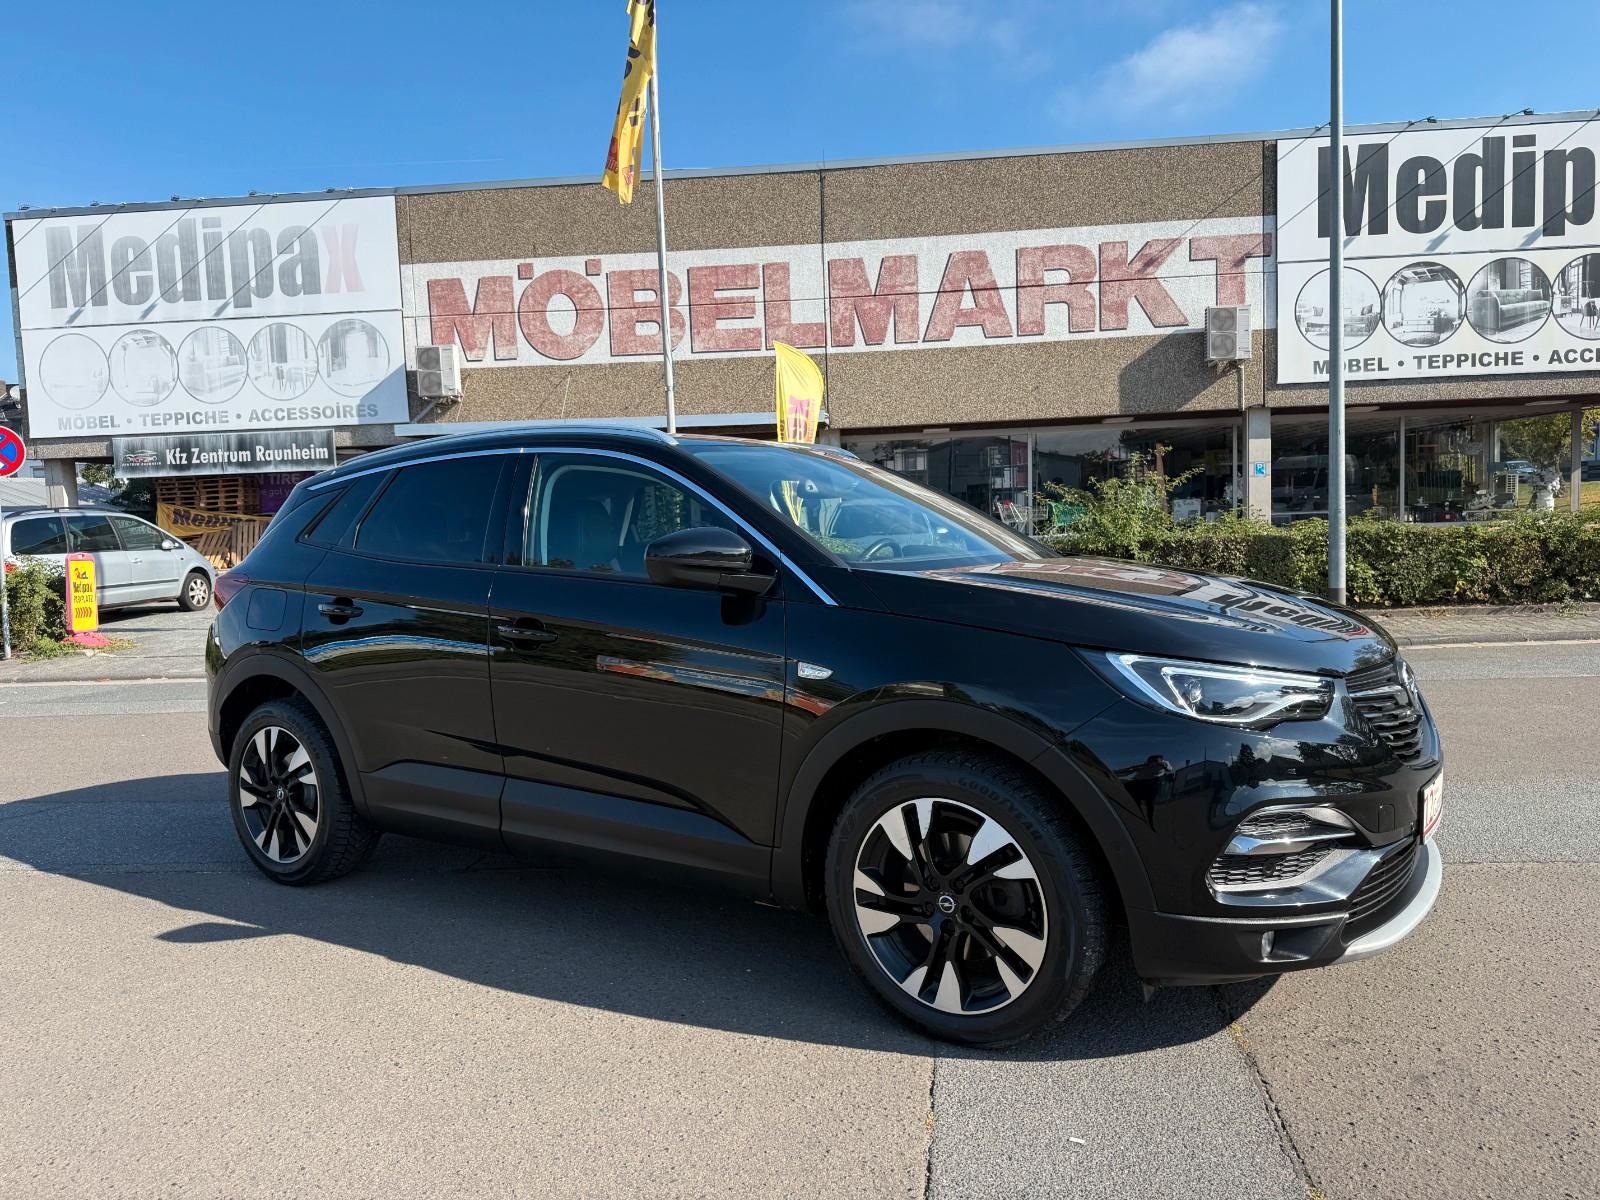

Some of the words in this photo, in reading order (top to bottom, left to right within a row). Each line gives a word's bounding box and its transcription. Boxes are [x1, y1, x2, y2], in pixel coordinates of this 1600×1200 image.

[45, 216, 366, 309] Medipax
[427, 232, 1273, 362] MÖBELMARKT
[1313, 357, 1389, 374] MBEL
[1413, 351, 1523, 369] TEPPICHE
[58, 412, 120, 431] MÖBEL
[138, 410, 229, 427] TEPPICHE
[166, 449, 188, 465] Kfz
[191, 446, 250, 463] Zentrum
[255, 443, 328, 462] Raunheim
